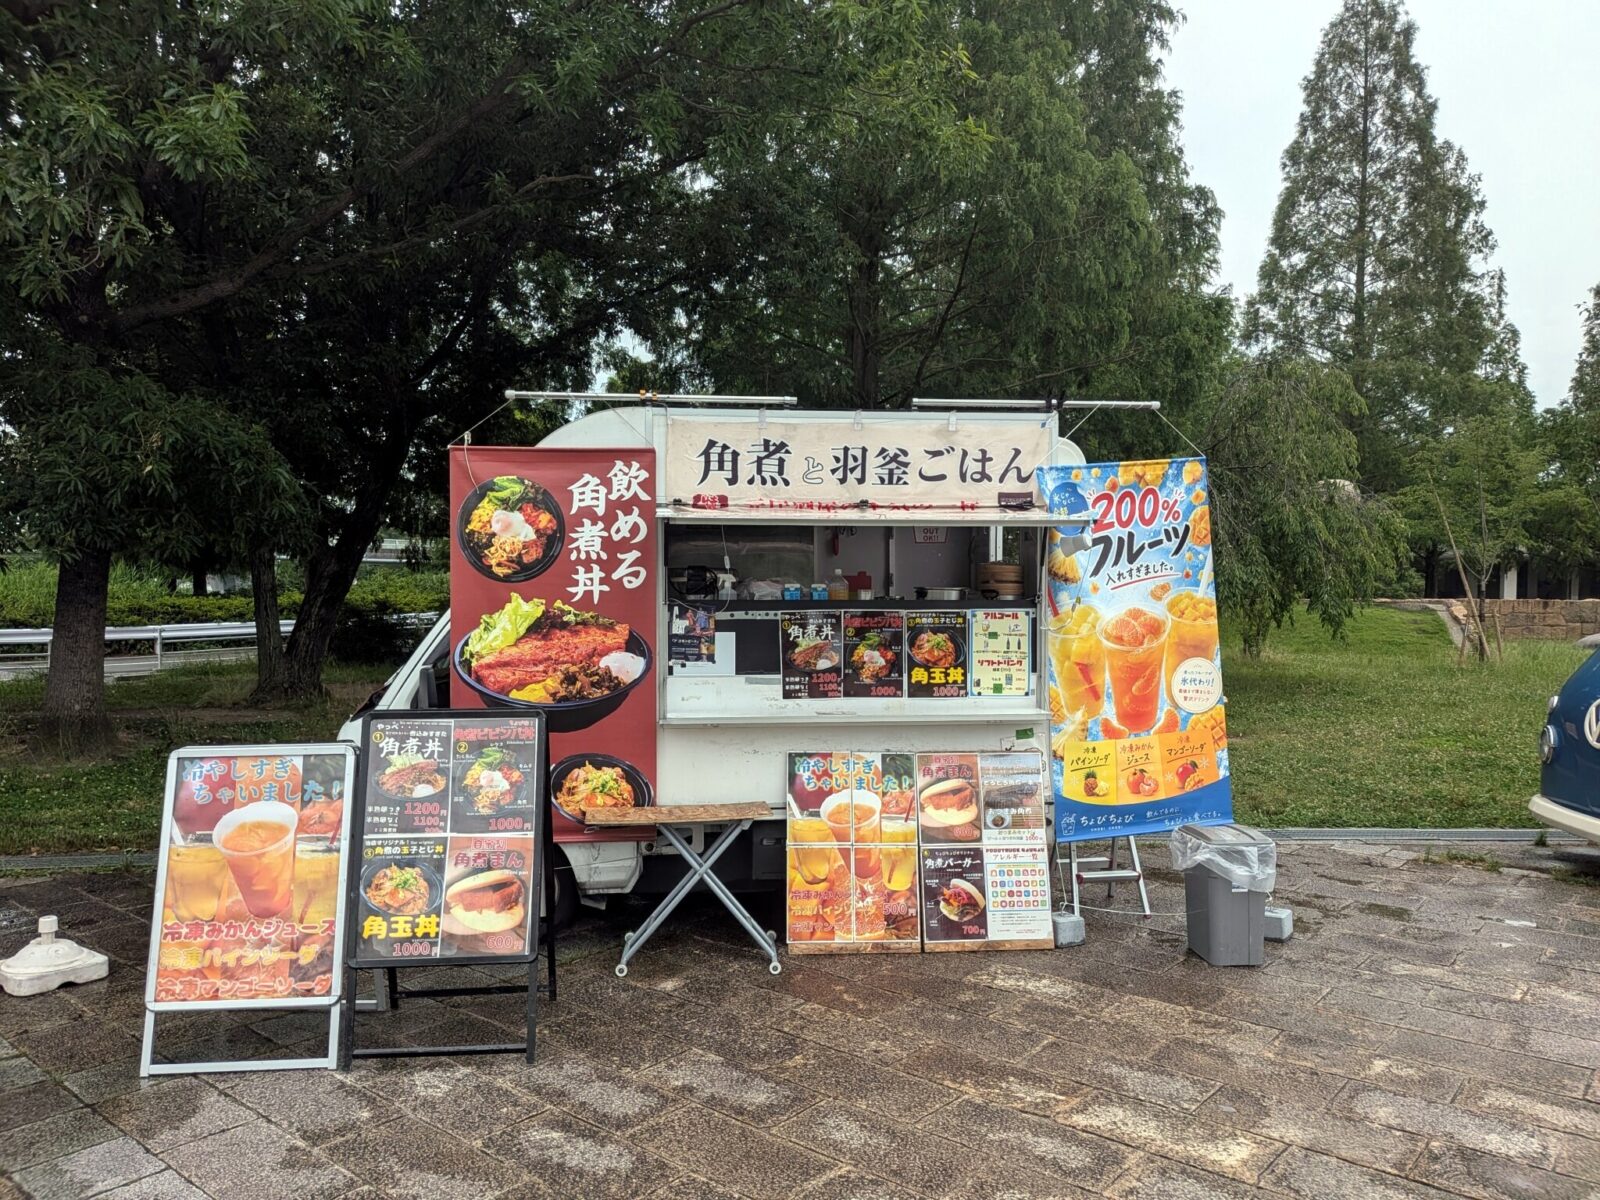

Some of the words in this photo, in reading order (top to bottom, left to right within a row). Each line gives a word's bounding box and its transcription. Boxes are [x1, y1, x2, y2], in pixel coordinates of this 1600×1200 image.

[696, 438, 1034, 488] 角煮と羽釜ごはん
[1091, 486, 1182, 533] 200%
[606, 460, 652, 590] 飲める
[566, 473, 610, 605] 角煮丼
[1089, 524, 1191, 578] フルーツ
[1106, 561, 1174, 586] 入れすぎました。
[983, 612, 1020, 620] アルコール
[911, 667, 965, 685] 角玉丼
[1083, 746, 1097, 754] 冷凍
[1119, 742, 1154, 754] 冷凍みかん
[1167, 742, 1207, 757] マンゴーソーダ
[794, 757, 876, 774] 冷やしすぎ
[1070, 753, 1111, 766] パインソーダ
[1127, 753, 1151, 765] ジュース
[182, 757, 295, 781] 冷やしすぎ
[921, 765, 972, 778] 角煮まん
[404, 801, 447, 817] 1200円
[413, 816, 445, 827] 1100円
[488, 816, 531, 831] 1000円
[1079, 813, 1135, 828] ちょびちょび
[375, 845, 444, 856] 角煮の玉子とじ丼
[454, 851, 524, 868] 角煮まん
[925, 857, 981, 869] 角煮バーガー
[883, 902, 917, 916] 500円
[162, 919, 336, 941] 冷凍みかんジュース
[362, 914, 440, 939] 角玉丼
[962, 925, 986, 935] 700円
[487, 935, 523, 950] 600円
[159, 943, 322, 970] 冷凍パインソーダ
[156, 975, 333, 1000] 冷凍マンゴーソーダ
